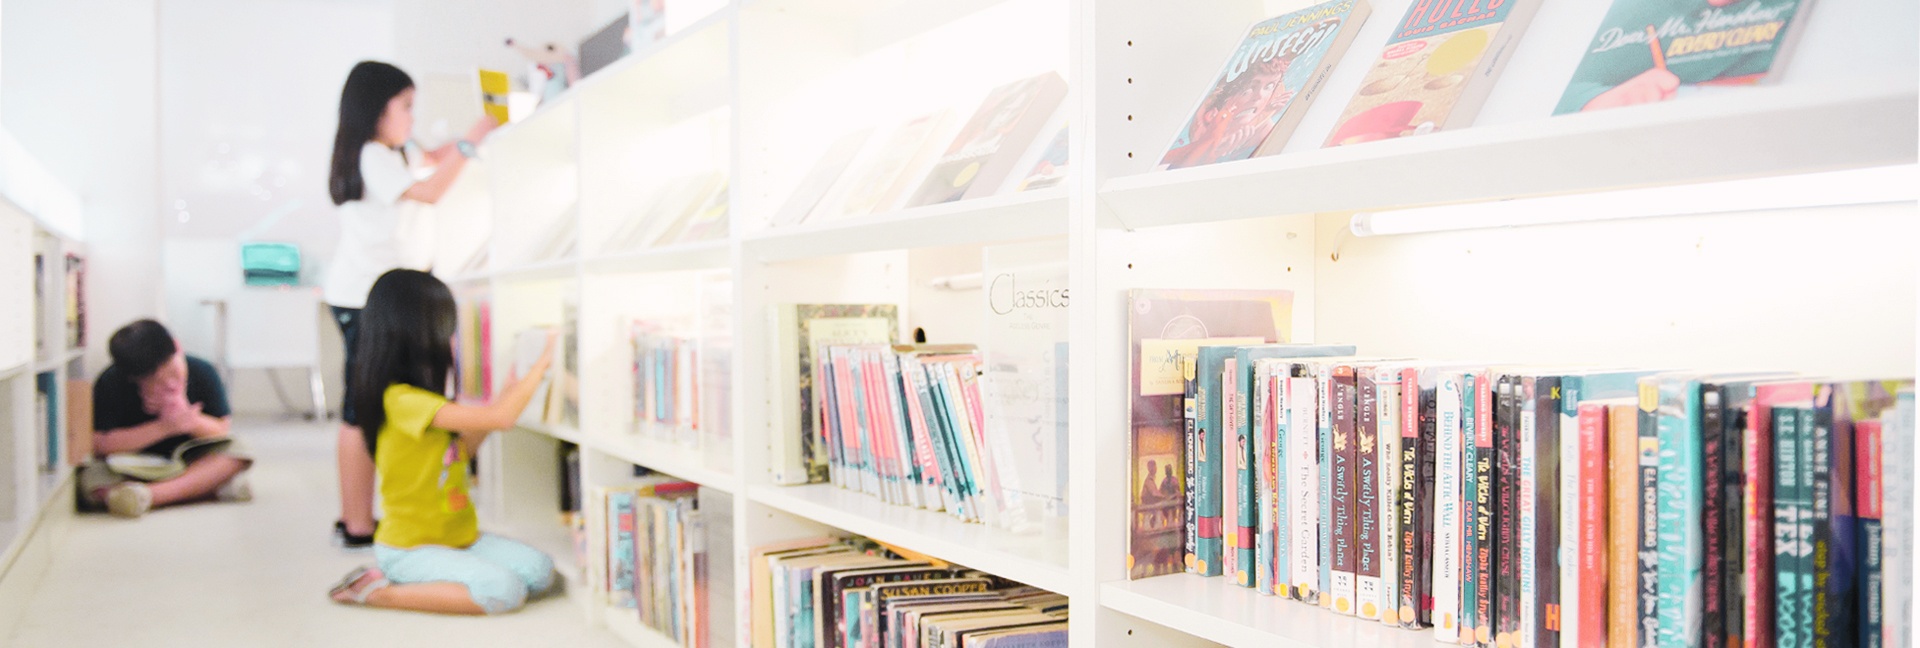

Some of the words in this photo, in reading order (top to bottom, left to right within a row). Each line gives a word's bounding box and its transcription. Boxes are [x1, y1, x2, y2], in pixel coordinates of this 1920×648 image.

[1250, 23, 1281, 39] PAUL
[1280, 1, 1353, 31] JENNINGS
[1397, 24, 1435, 39] LOUIS
[1438, 11, 1496, 29] SACHAR
[1591, 27, 1650, 53] Dear
[1694, 2, 1795, 33] Henshaw
[990, 272, 1069, 315] Classics
[1363, 386, 1371, 422] L'ENGLE
[1465, 417, 1474, 449] BEVERLY
[1336, 455, 1346, 465] A
[1362, 457, 1372, 468] A
[1522, 456, 1532, 476] THE
[1778, 439, 1796, 487] HINTON
[1815, 427, 1829, 474] ANNE
[1300, 465, 1310, 487] The
[1465, 452, 1474, 483] CLEARY
[1643, 467, 1656, 486] E.L.
[1333, 466, 1348, 503] Swiftly
[1359, 469, 1375, 507] Swiftly
[1522, 479, 1532, 512] GREAT
[1815, 479, 1829, 520] FINE
[1300, 490, 1310, 525] Secret
[1334, 505, 1348, 536] Tilting
[1465, 500, 1473, 522] DEAR
[1643, 487, 1656, 547] KONIGSBURG
[1360, 509, 1375, 540] Tilting
[1522, 515, 1532, 544] GILLY
[1774, 505, 1798, 558] TEX
[1300, 529, 1310, 573] Garden
[1336, 538, 1348, 566] Planet
[1362, 543, 1375, 571] Planet
[1465, 540, 1473, 583] HENSHAW
[1501, 546, 1511, 577] CHASE
[847, 575, 886, 587] JOAN
[1522, 547, 1532, 594] HOPKINS
[881, 585, 930, 601] SUSAN
[931, 581, 989, 597] COOPER
